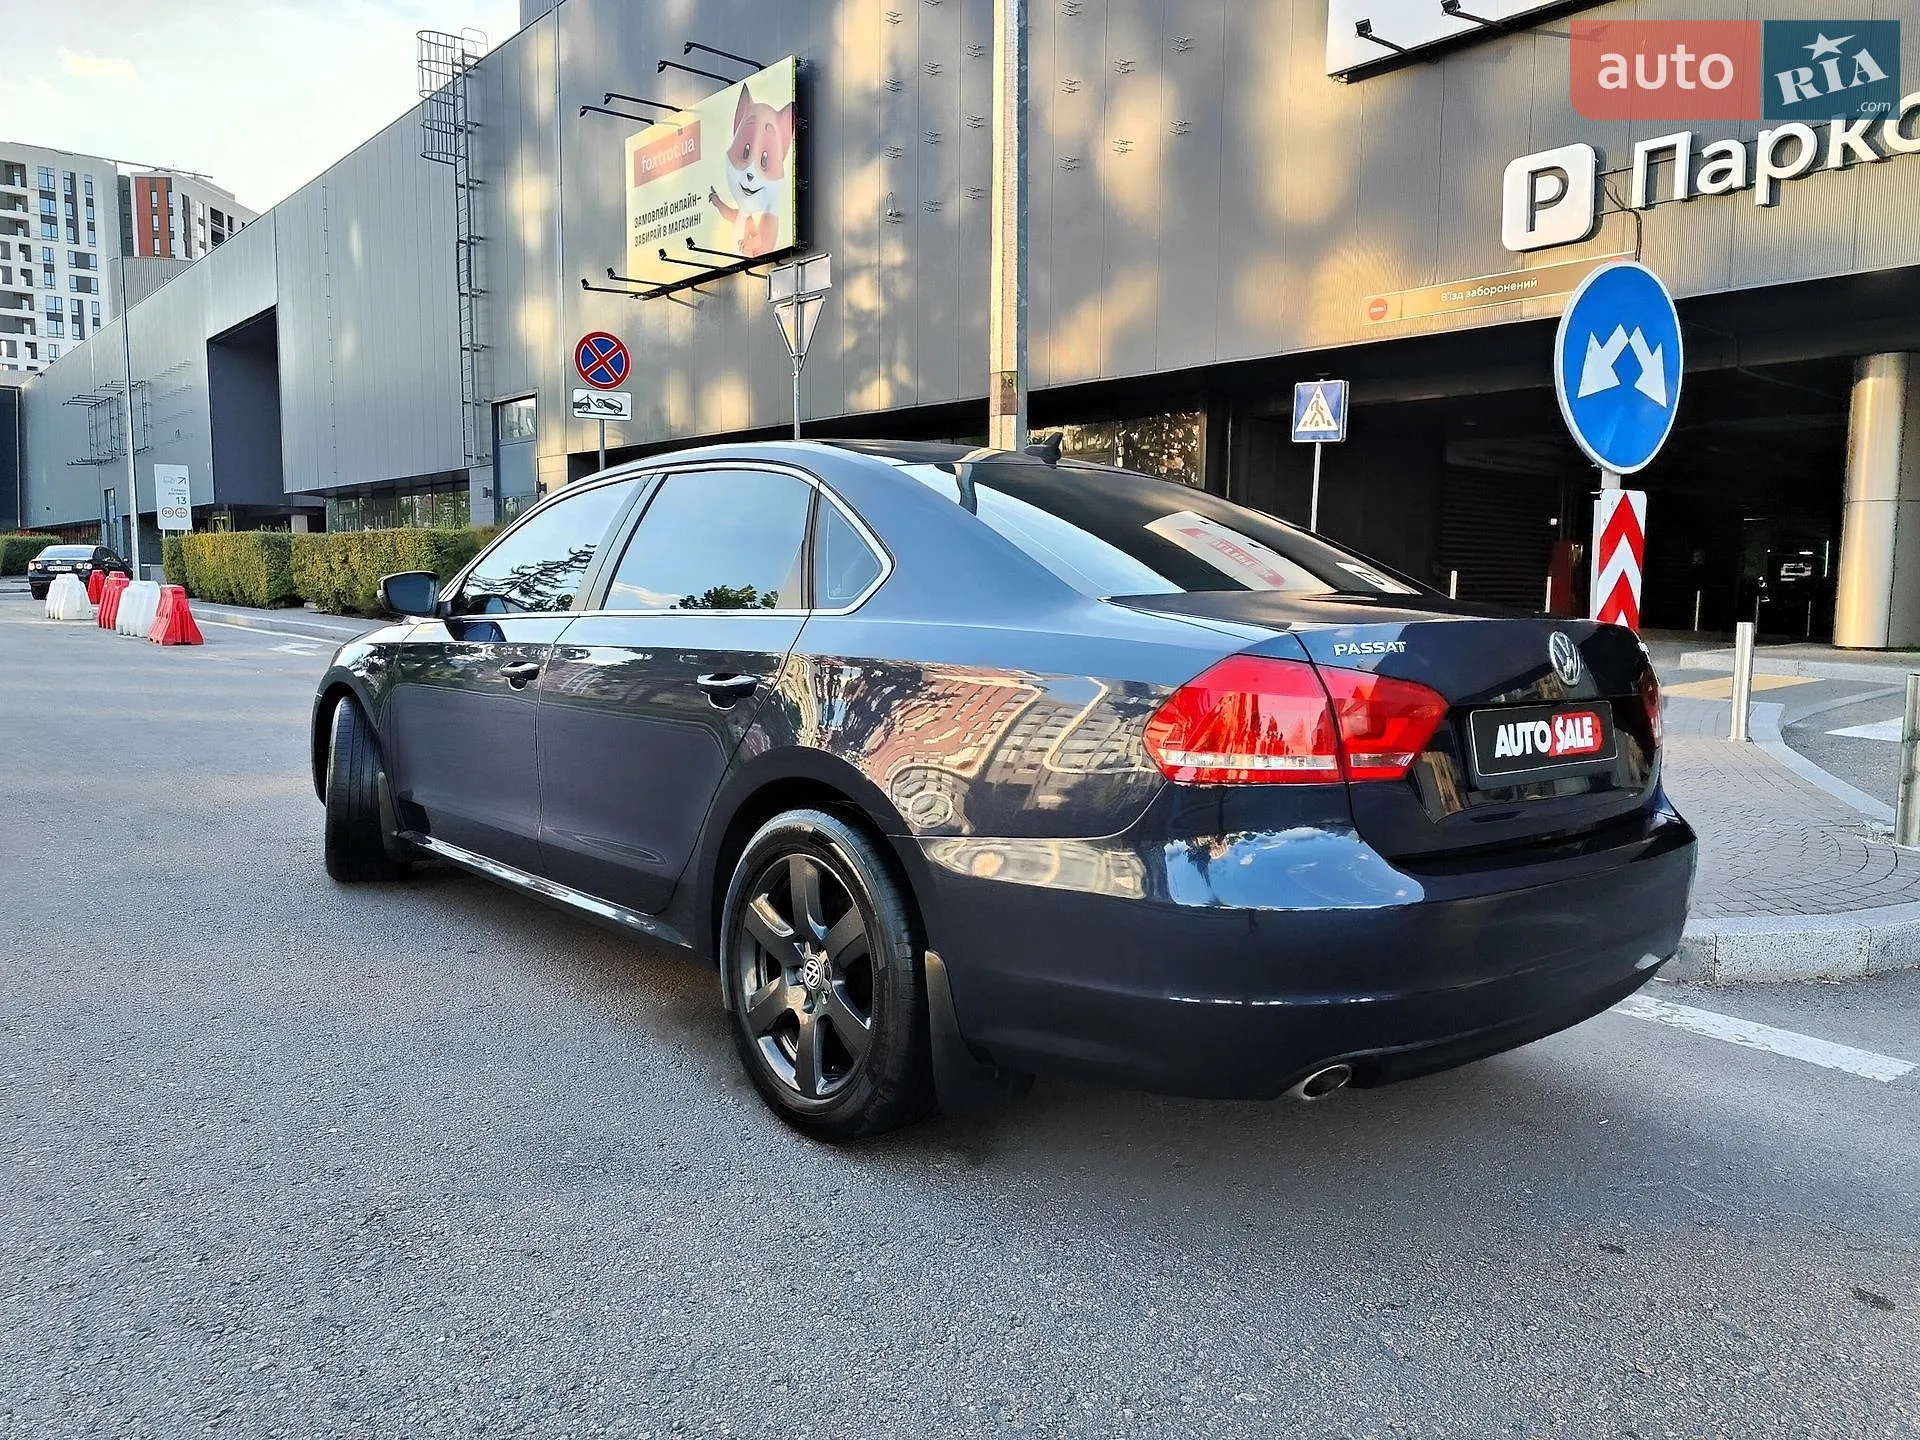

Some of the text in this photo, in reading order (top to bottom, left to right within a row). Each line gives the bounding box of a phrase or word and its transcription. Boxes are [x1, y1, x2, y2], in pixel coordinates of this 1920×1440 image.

[634, 202, 669, 229] ЗАМОВЛЯЙ
[634, 212, 702, 248] ЗАБИРАЙ В МАГАЗИНІ
[1465, 277, 1538, 299] заборонений
[176, 497, 187, 505] 13
[1333, 641, 1407, 657] PASSAT
[1494, 720, 1553, 759] AUTO
